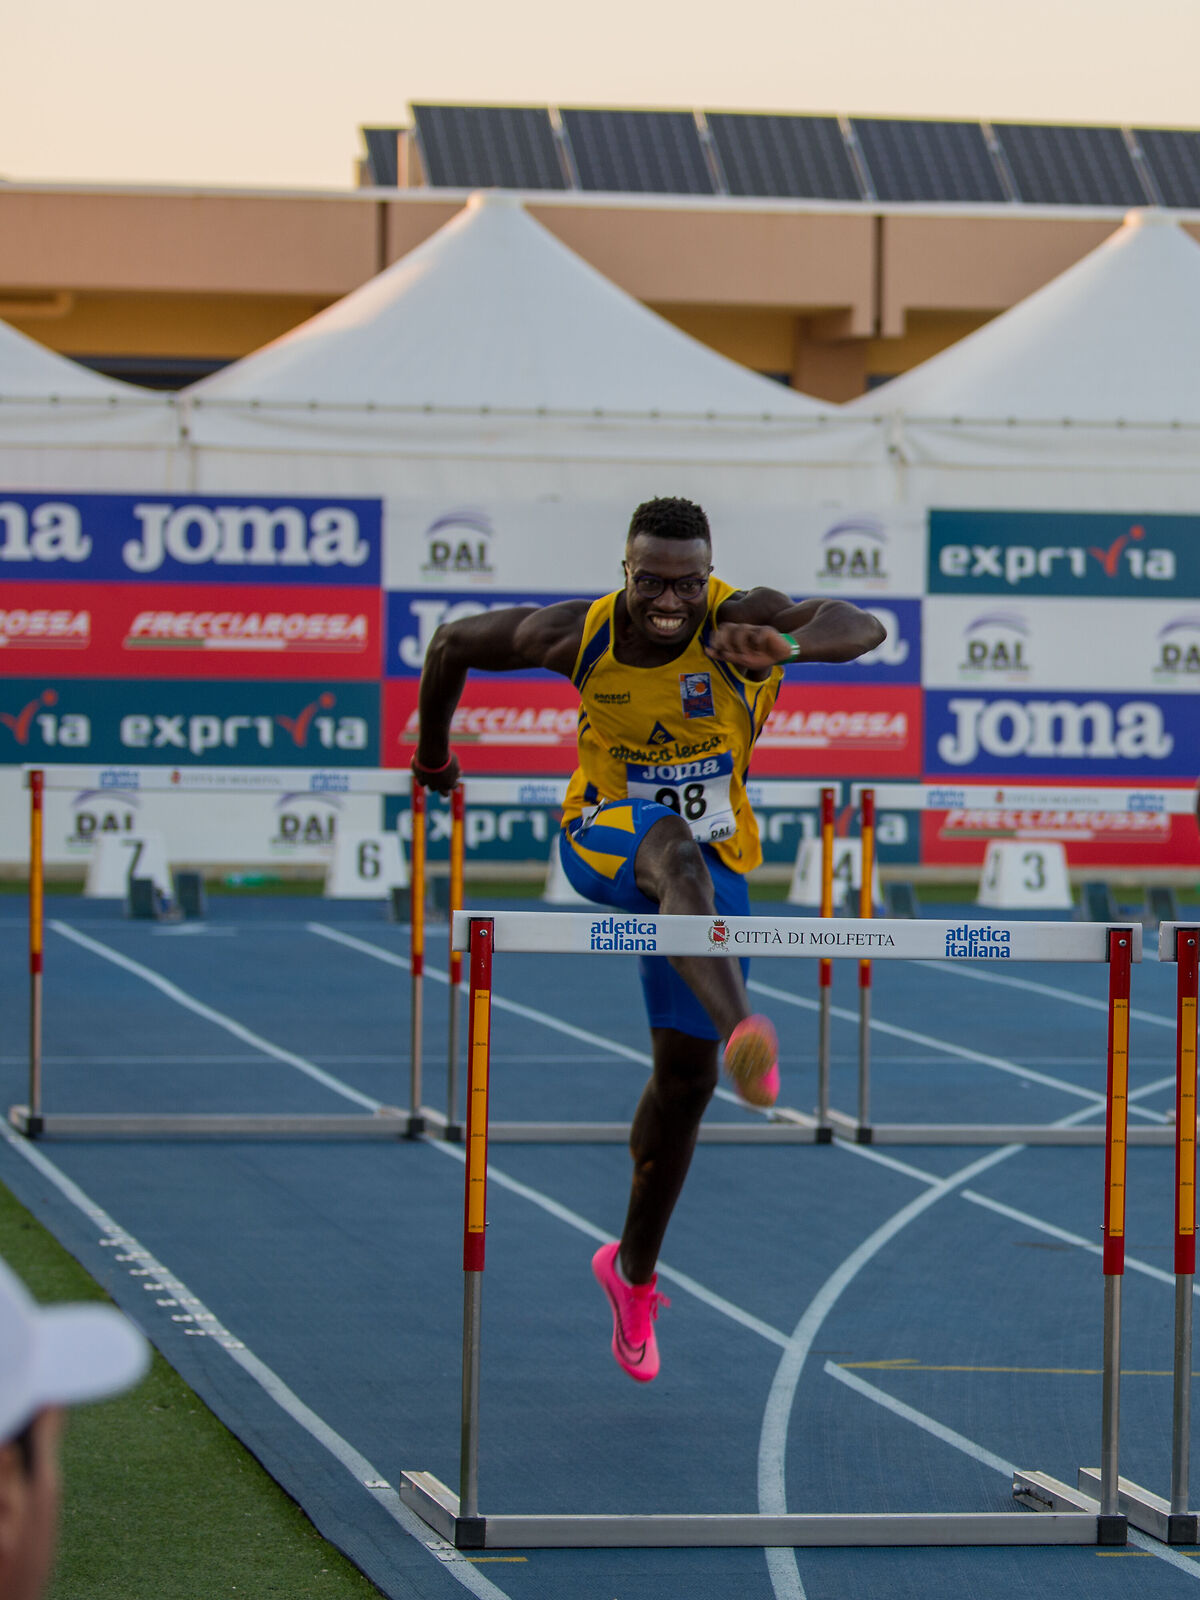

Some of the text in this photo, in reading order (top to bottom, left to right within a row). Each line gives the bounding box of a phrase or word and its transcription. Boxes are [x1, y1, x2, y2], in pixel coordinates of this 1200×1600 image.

[122, 503, 369, 573] Joma
[429, 540, 487, 566] DAI
[825, 548, 881, 572] DAI
[938, 524, 1177, 586] exprivia
[0, 609, 91, 637] OSSA
[130, 610, 368, 640] FRECCIAROSSA
[967, 640, 1024, 666] DAI
[120, 691, 368, 756] exprivia
[937, 698, 1174, 766] Joma
[642, 758, 720, 781] Joma
[655, 783, 707, 821] 98
[76, 812, 134, 837] DAI
[279, 813, 337, 839] DAI
[711, 827, 729, 840] DAI
[122, 839, 144, 879] 7
[357, 840, 382, 880] 6
[1022, 851, 1046, 891] 3
[591, 917, 656, 935] atletica
[734, 928, 896, 946] CITTÀ DI MOLFETTA
[945, 924, 1011, 942] atletica
[591, 933, 656, 951] italiana
[945, 940, 1011, 958] italiana
